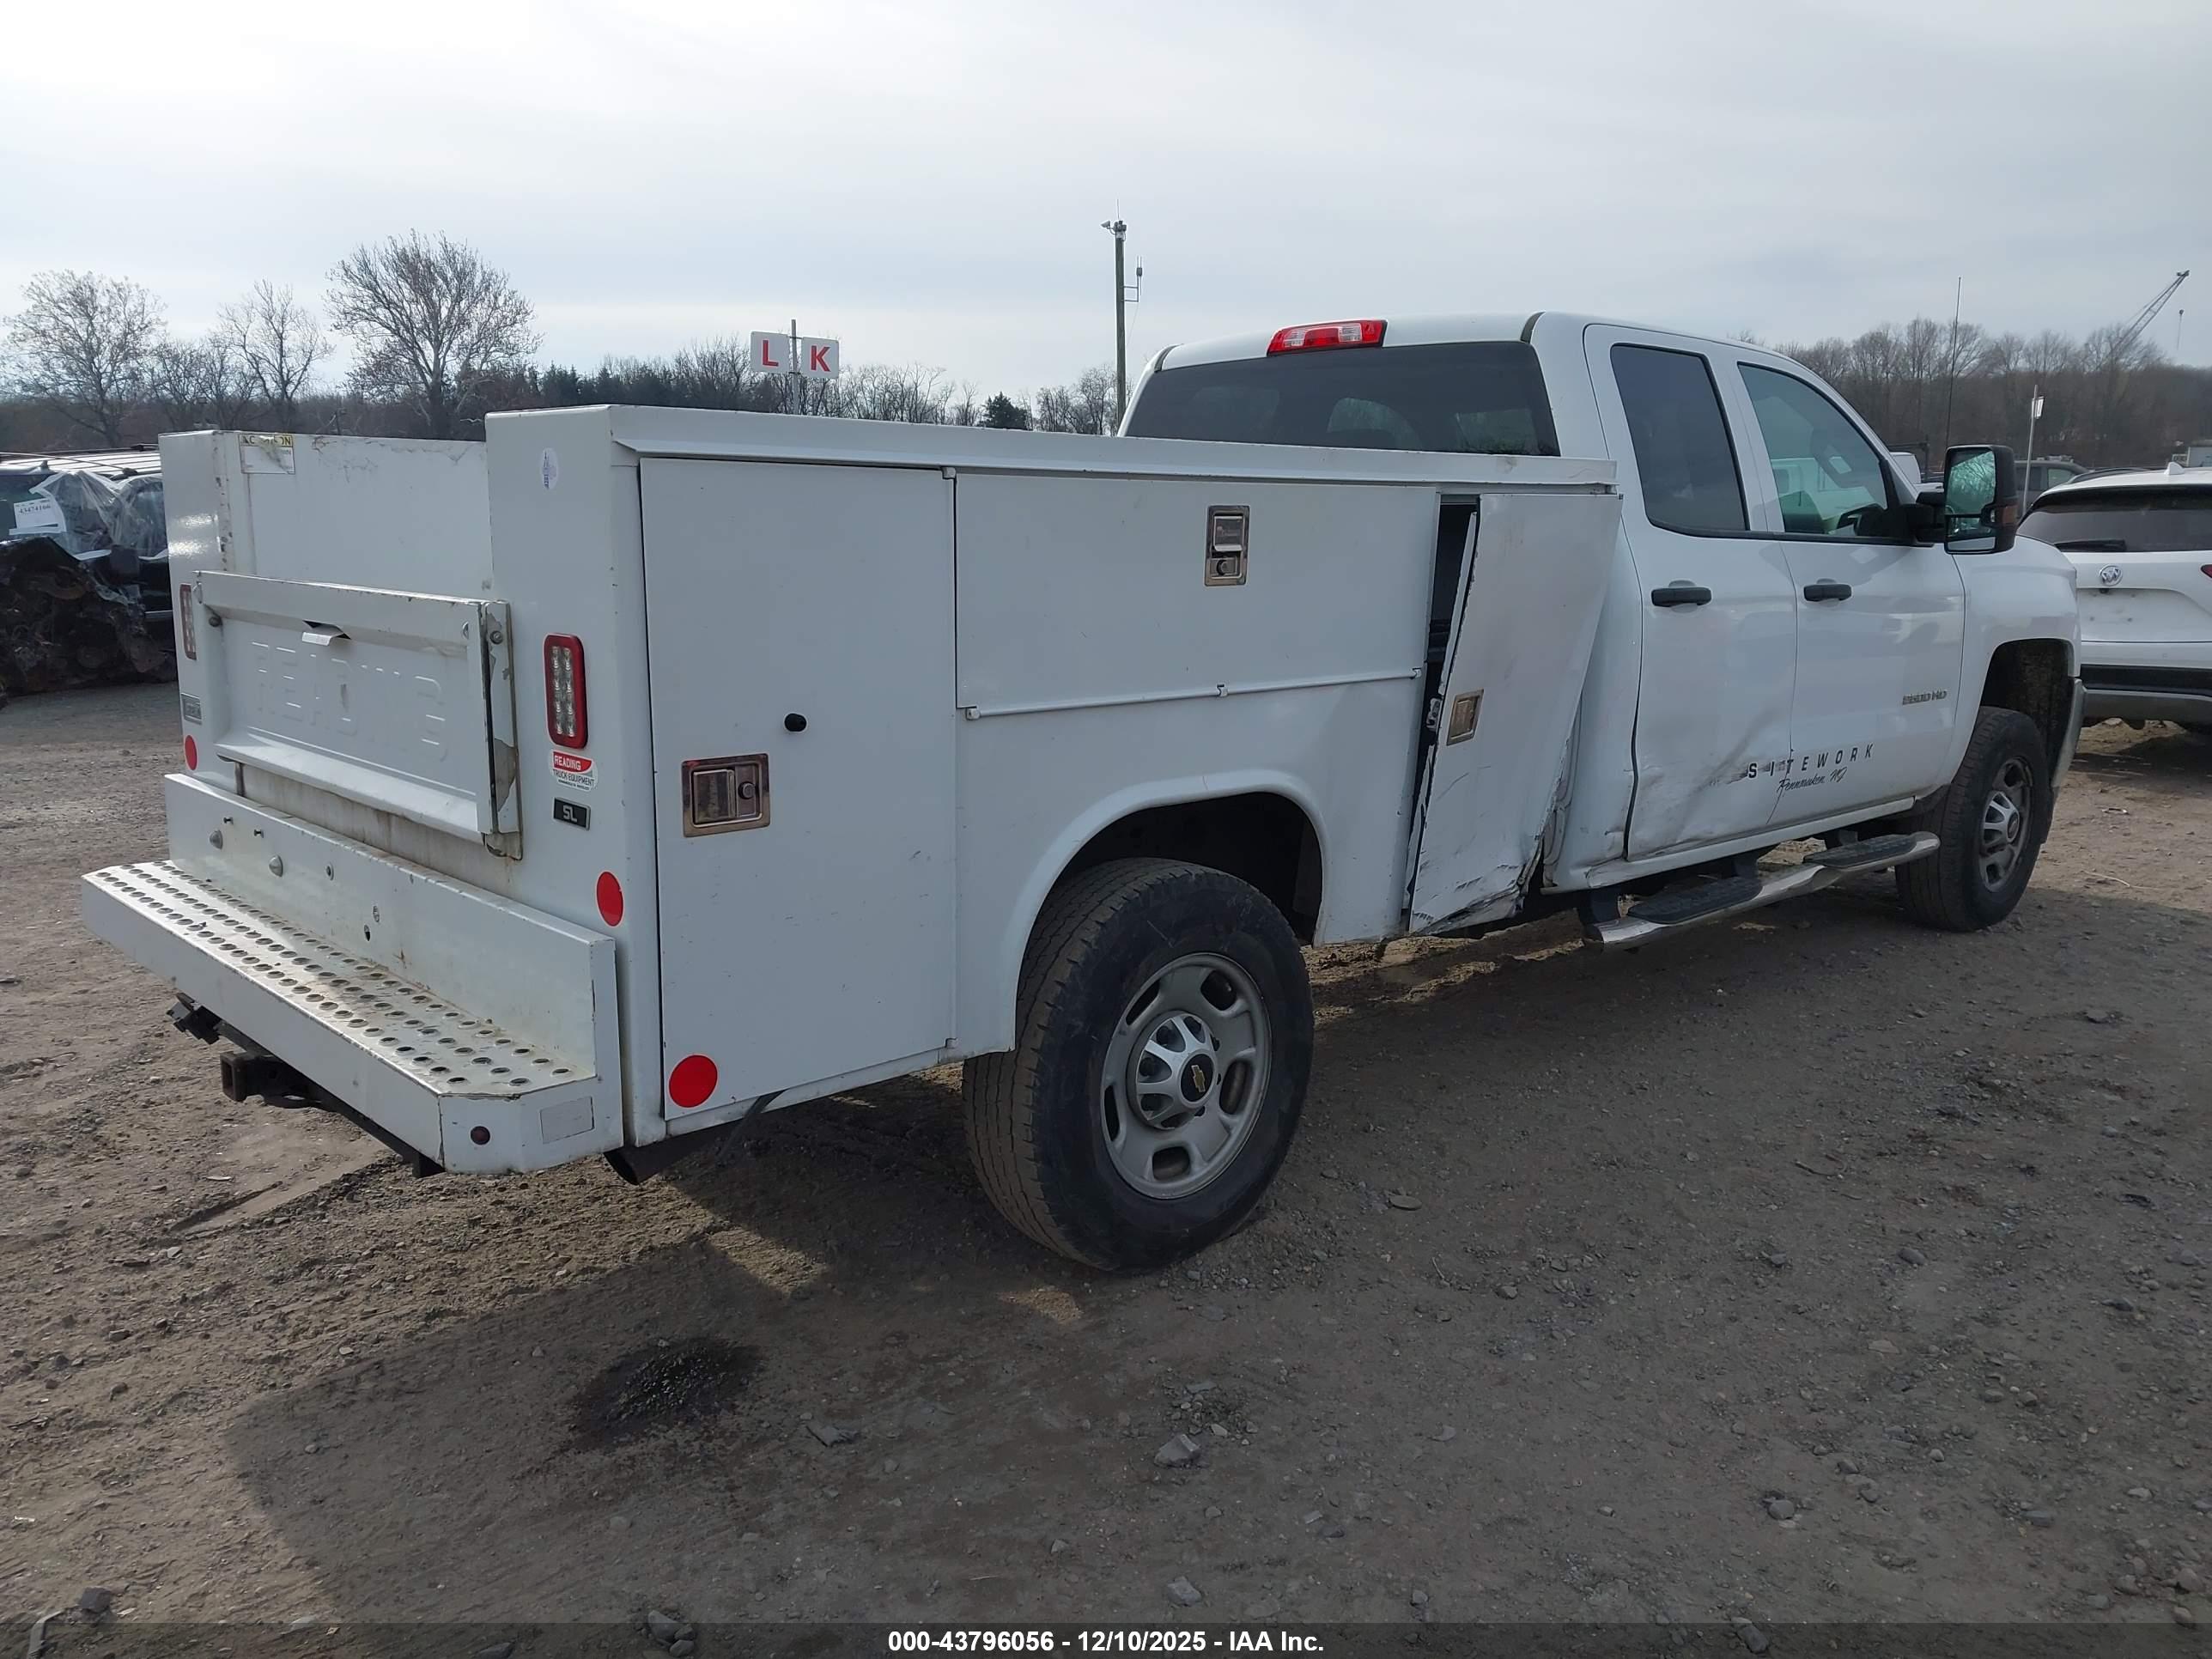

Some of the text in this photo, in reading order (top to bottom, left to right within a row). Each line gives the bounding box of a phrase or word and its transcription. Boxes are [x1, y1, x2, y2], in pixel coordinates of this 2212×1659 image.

[762, 339, 779, 368] L
[810, 344, 831, 373] K
[554, 755, 581, 771] READING
[1748, 744, 1874, 779] SITEWORK
